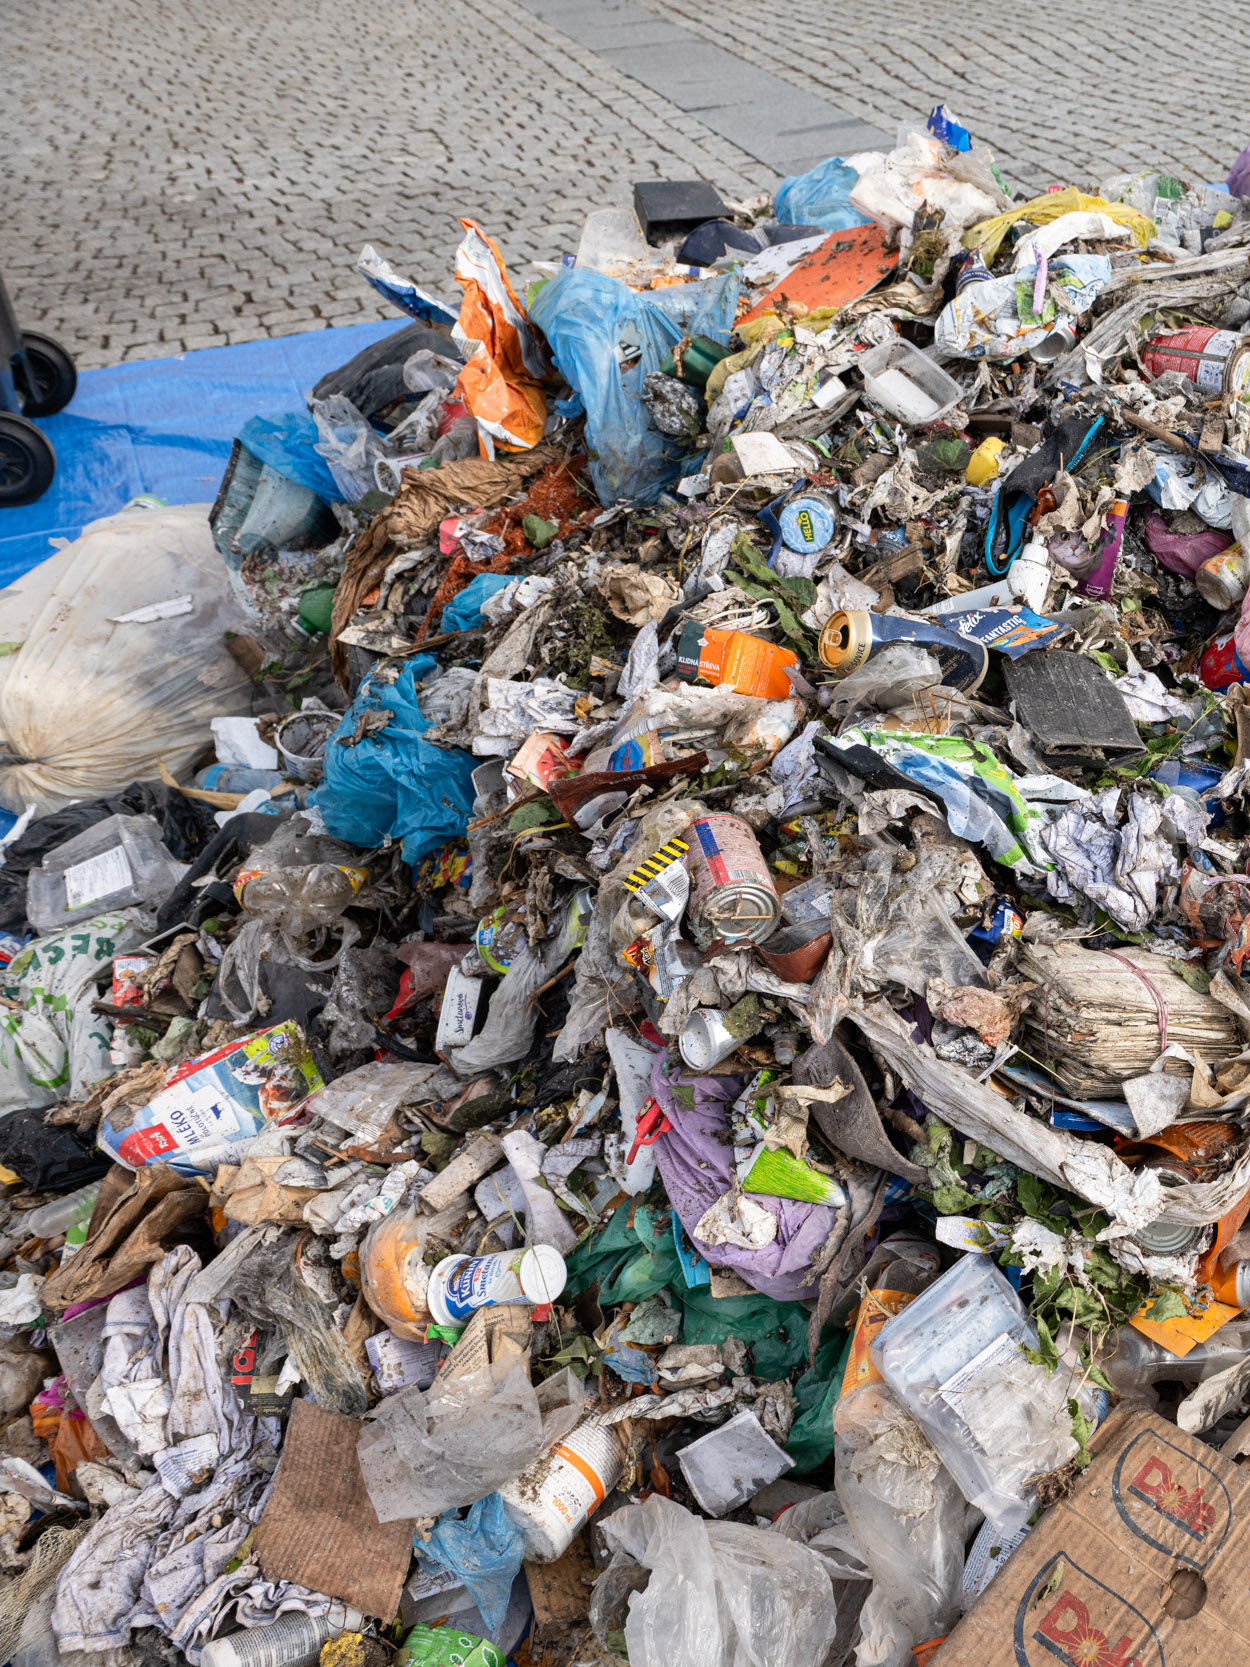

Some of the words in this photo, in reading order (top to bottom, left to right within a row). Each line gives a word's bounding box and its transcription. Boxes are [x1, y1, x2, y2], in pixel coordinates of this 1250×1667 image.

[800, 512, 813, 541] HELLO
[958, 609, 984, 633] felix
[981, 614, 1022, 643] FANTASTIC
[678, 656, 698, 666] KLIDNÁ
[699, 660, 720, 671] STŘEVA
[170, 1110, 201, 1146] MLÉKO
[552, 1497, 567, 1515] 1000
[1128, 1455, 1217, 1534] Dole
